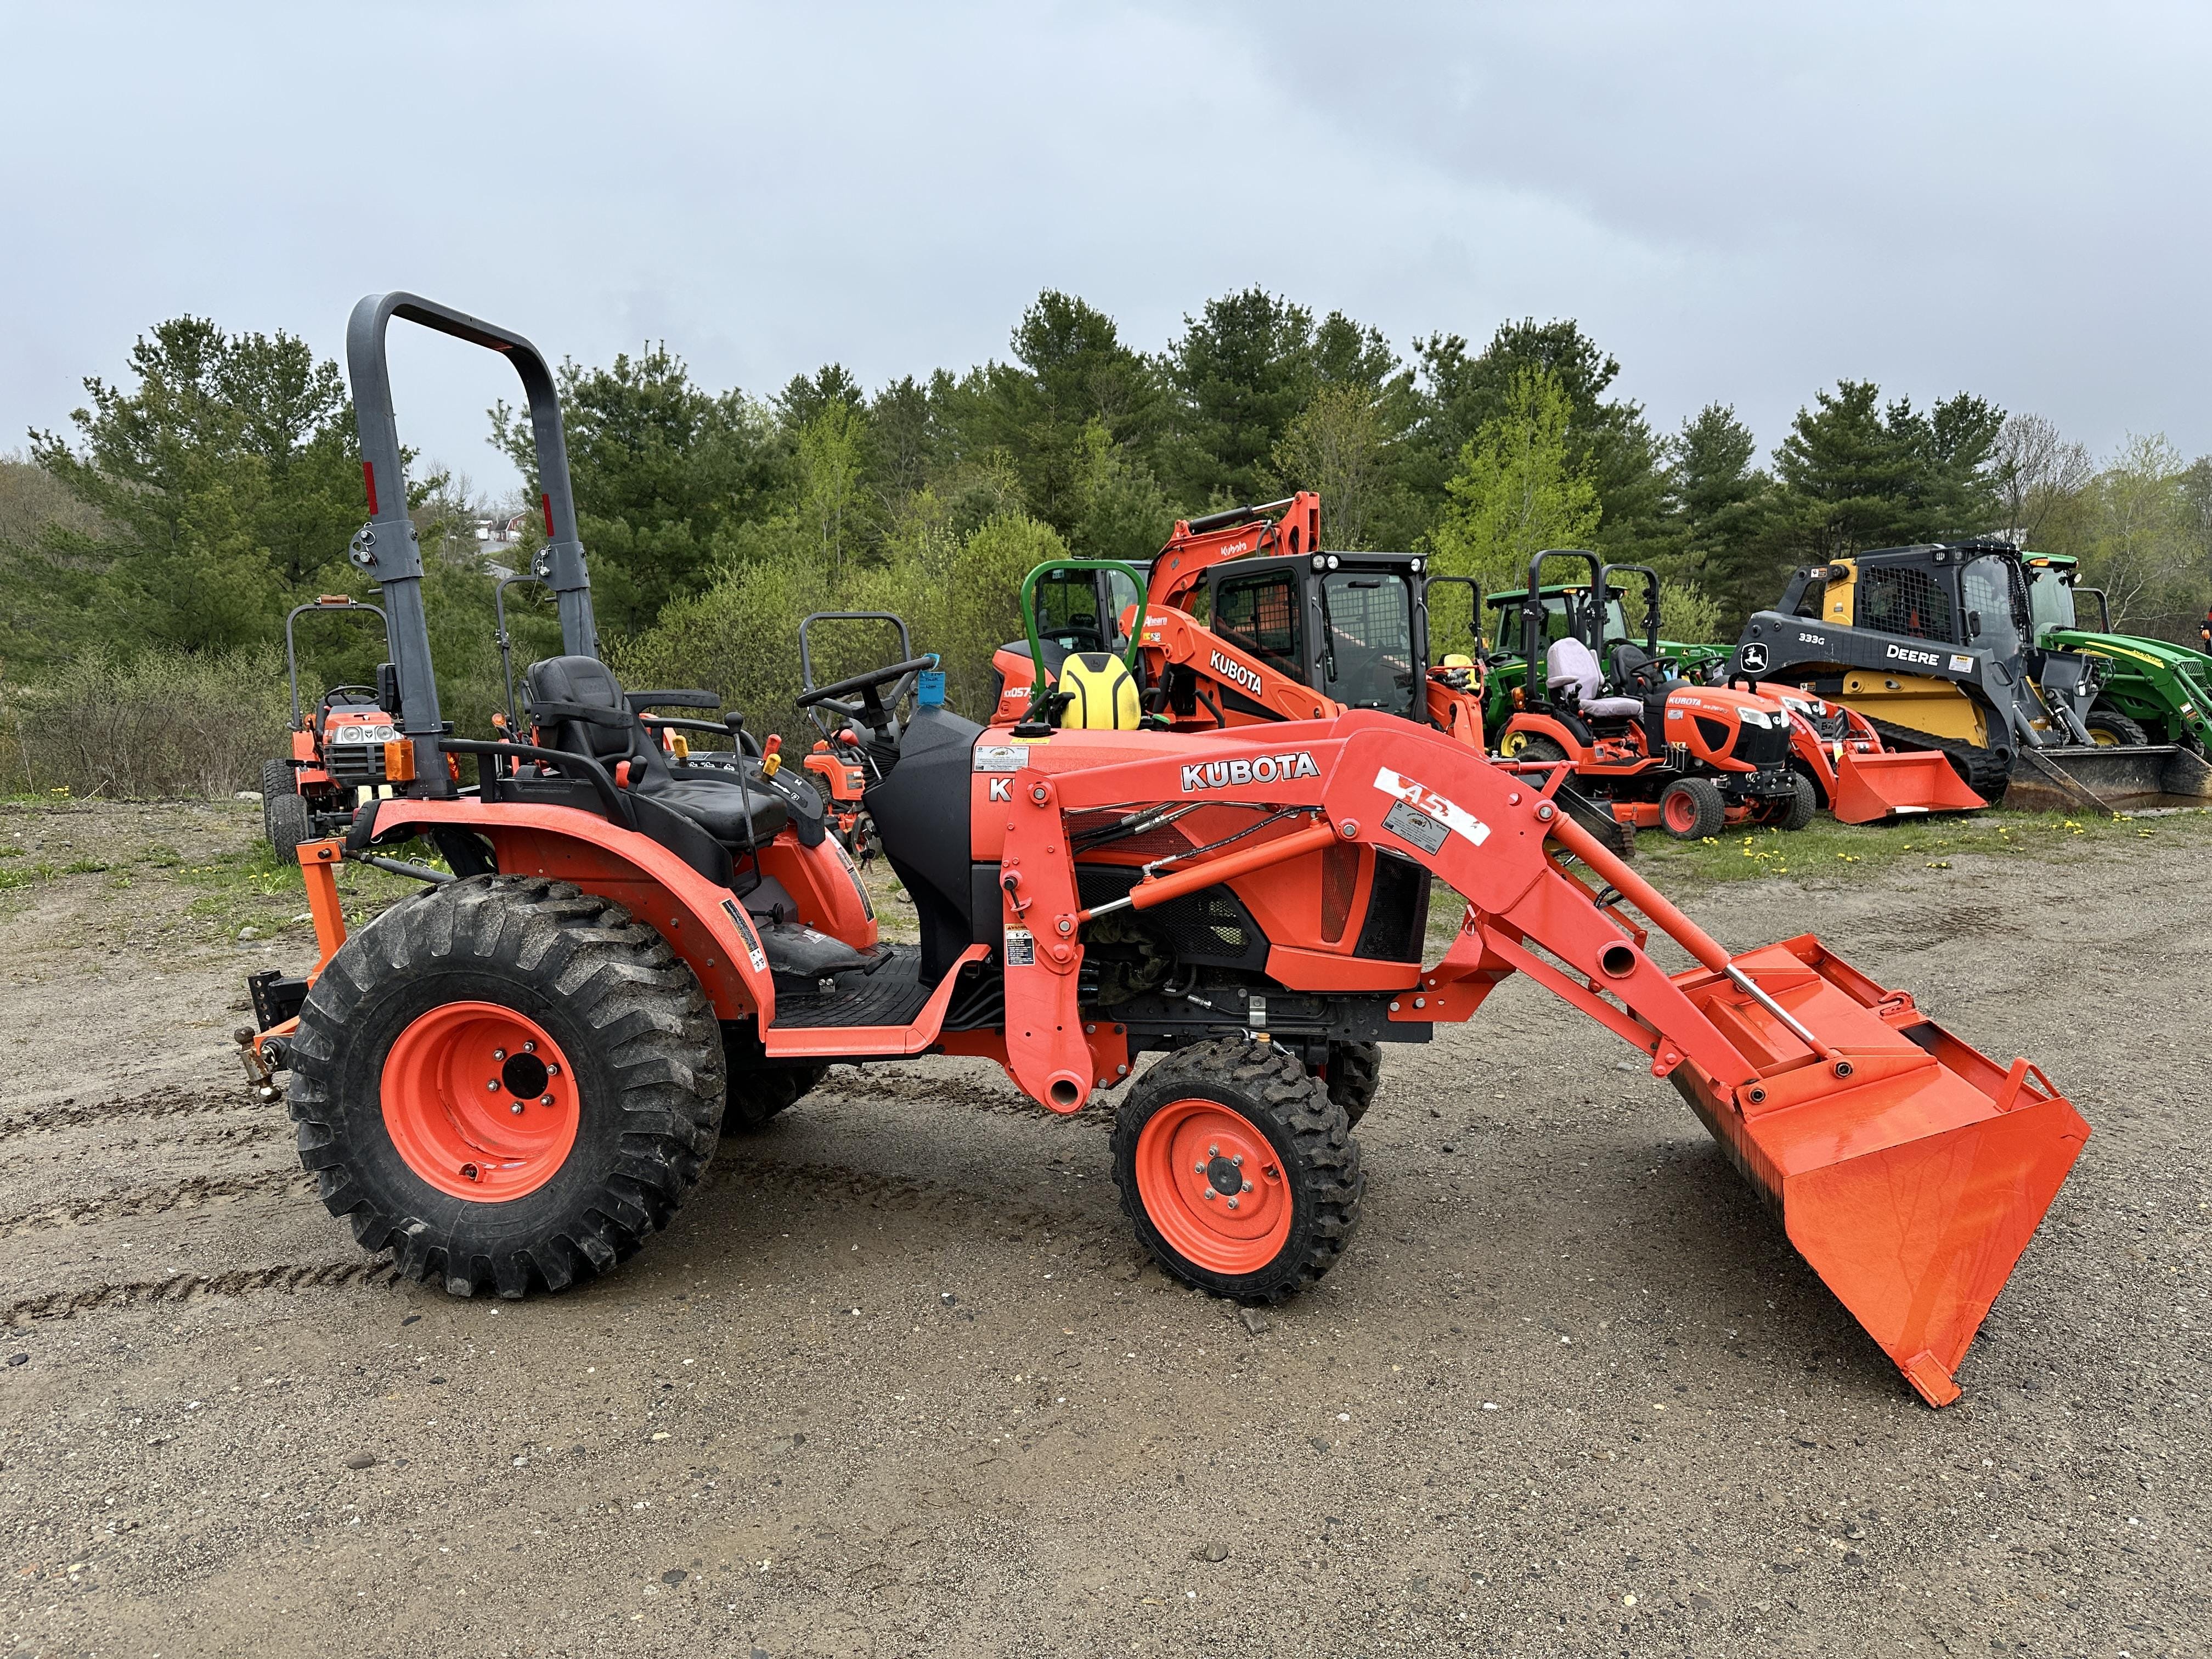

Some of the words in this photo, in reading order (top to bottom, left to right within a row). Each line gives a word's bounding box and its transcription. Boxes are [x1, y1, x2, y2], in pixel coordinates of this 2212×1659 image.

[1220, 540, 1247, 556] Kubota
[1798, 633, 1825, 645] 333G
[1886, 644, 1939, 666] DEERE
[1210, 649, 1261, 696] KUBOTA
[1668, 697, 1701, 706] KUBOTA
[1821, 721, 1833, 730] BX
[1181, 752, 1320, 791] KUBOTA
[989, 777, 1015, 802] K
